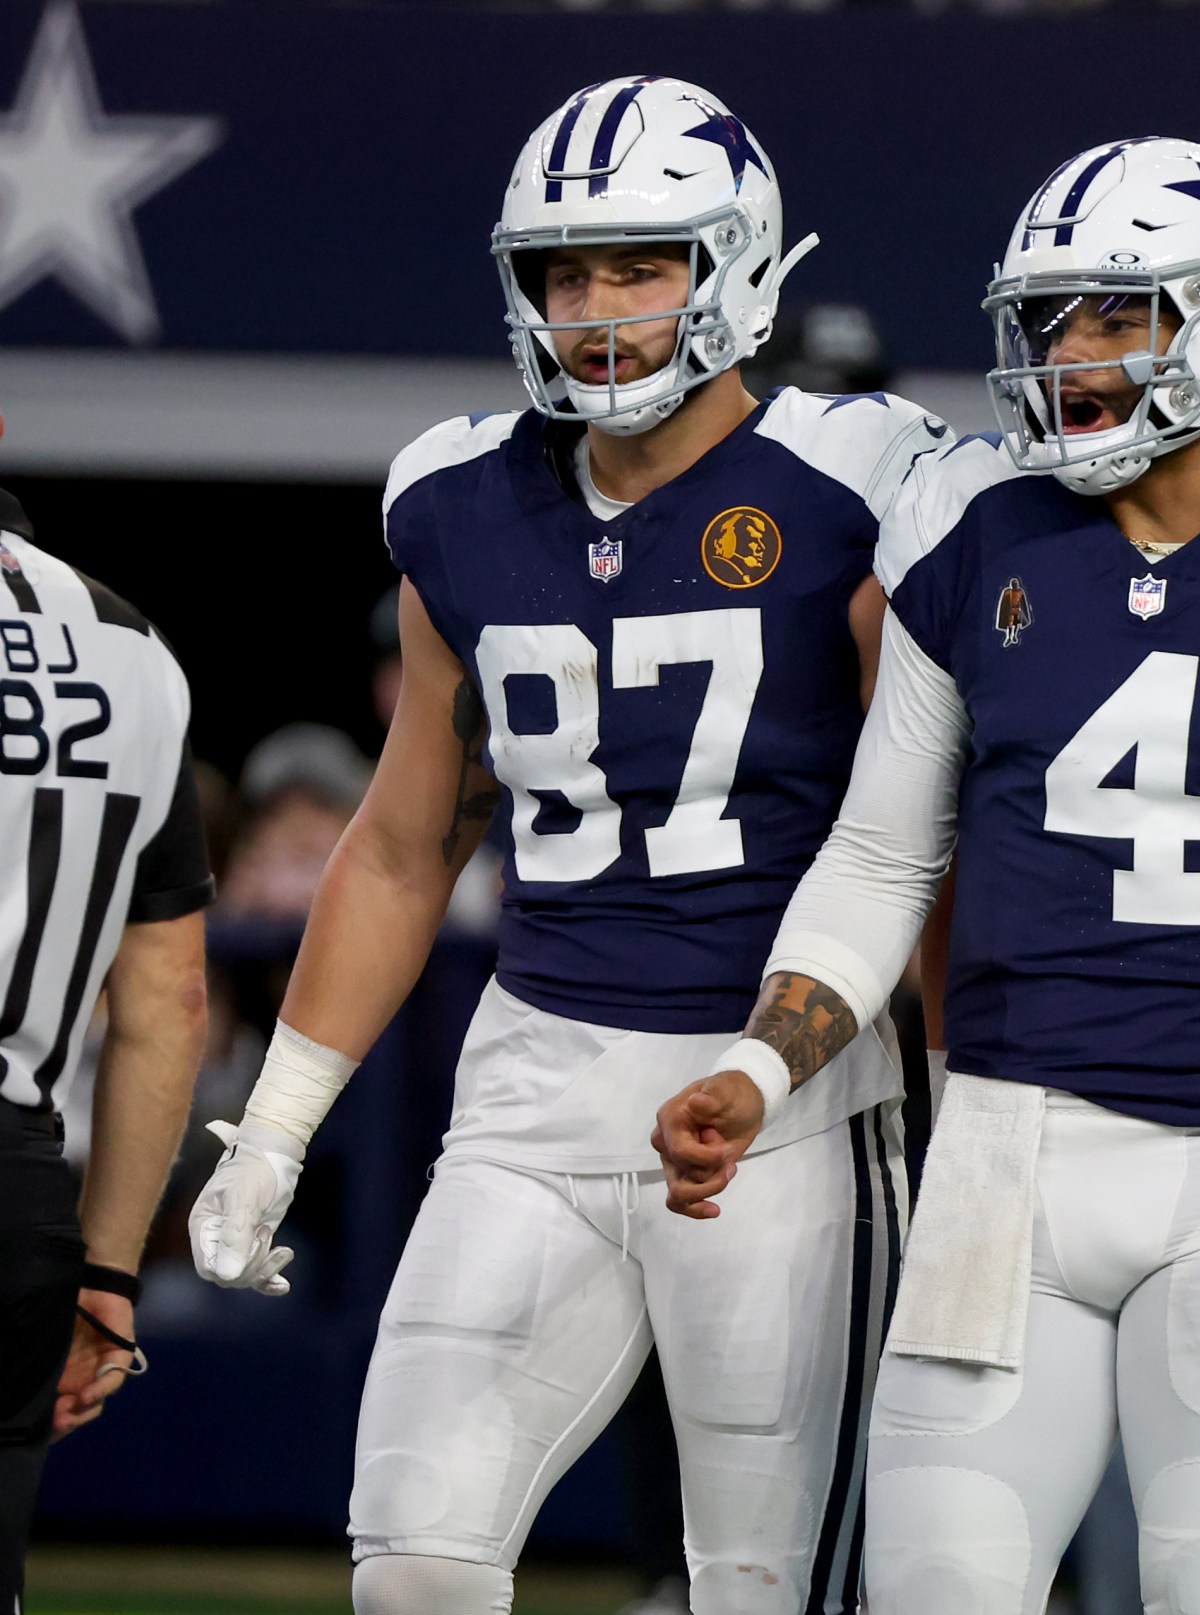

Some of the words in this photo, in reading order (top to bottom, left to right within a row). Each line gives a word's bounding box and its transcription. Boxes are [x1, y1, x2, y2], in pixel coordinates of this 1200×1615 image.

[594, 557, 617, 574] NFL
[1134, 592, 1158, 610] NFL
[0, 619, 78, 674] BJ
[0, 678, 111, 779] 82
[475, 608, 764, 882] 87
